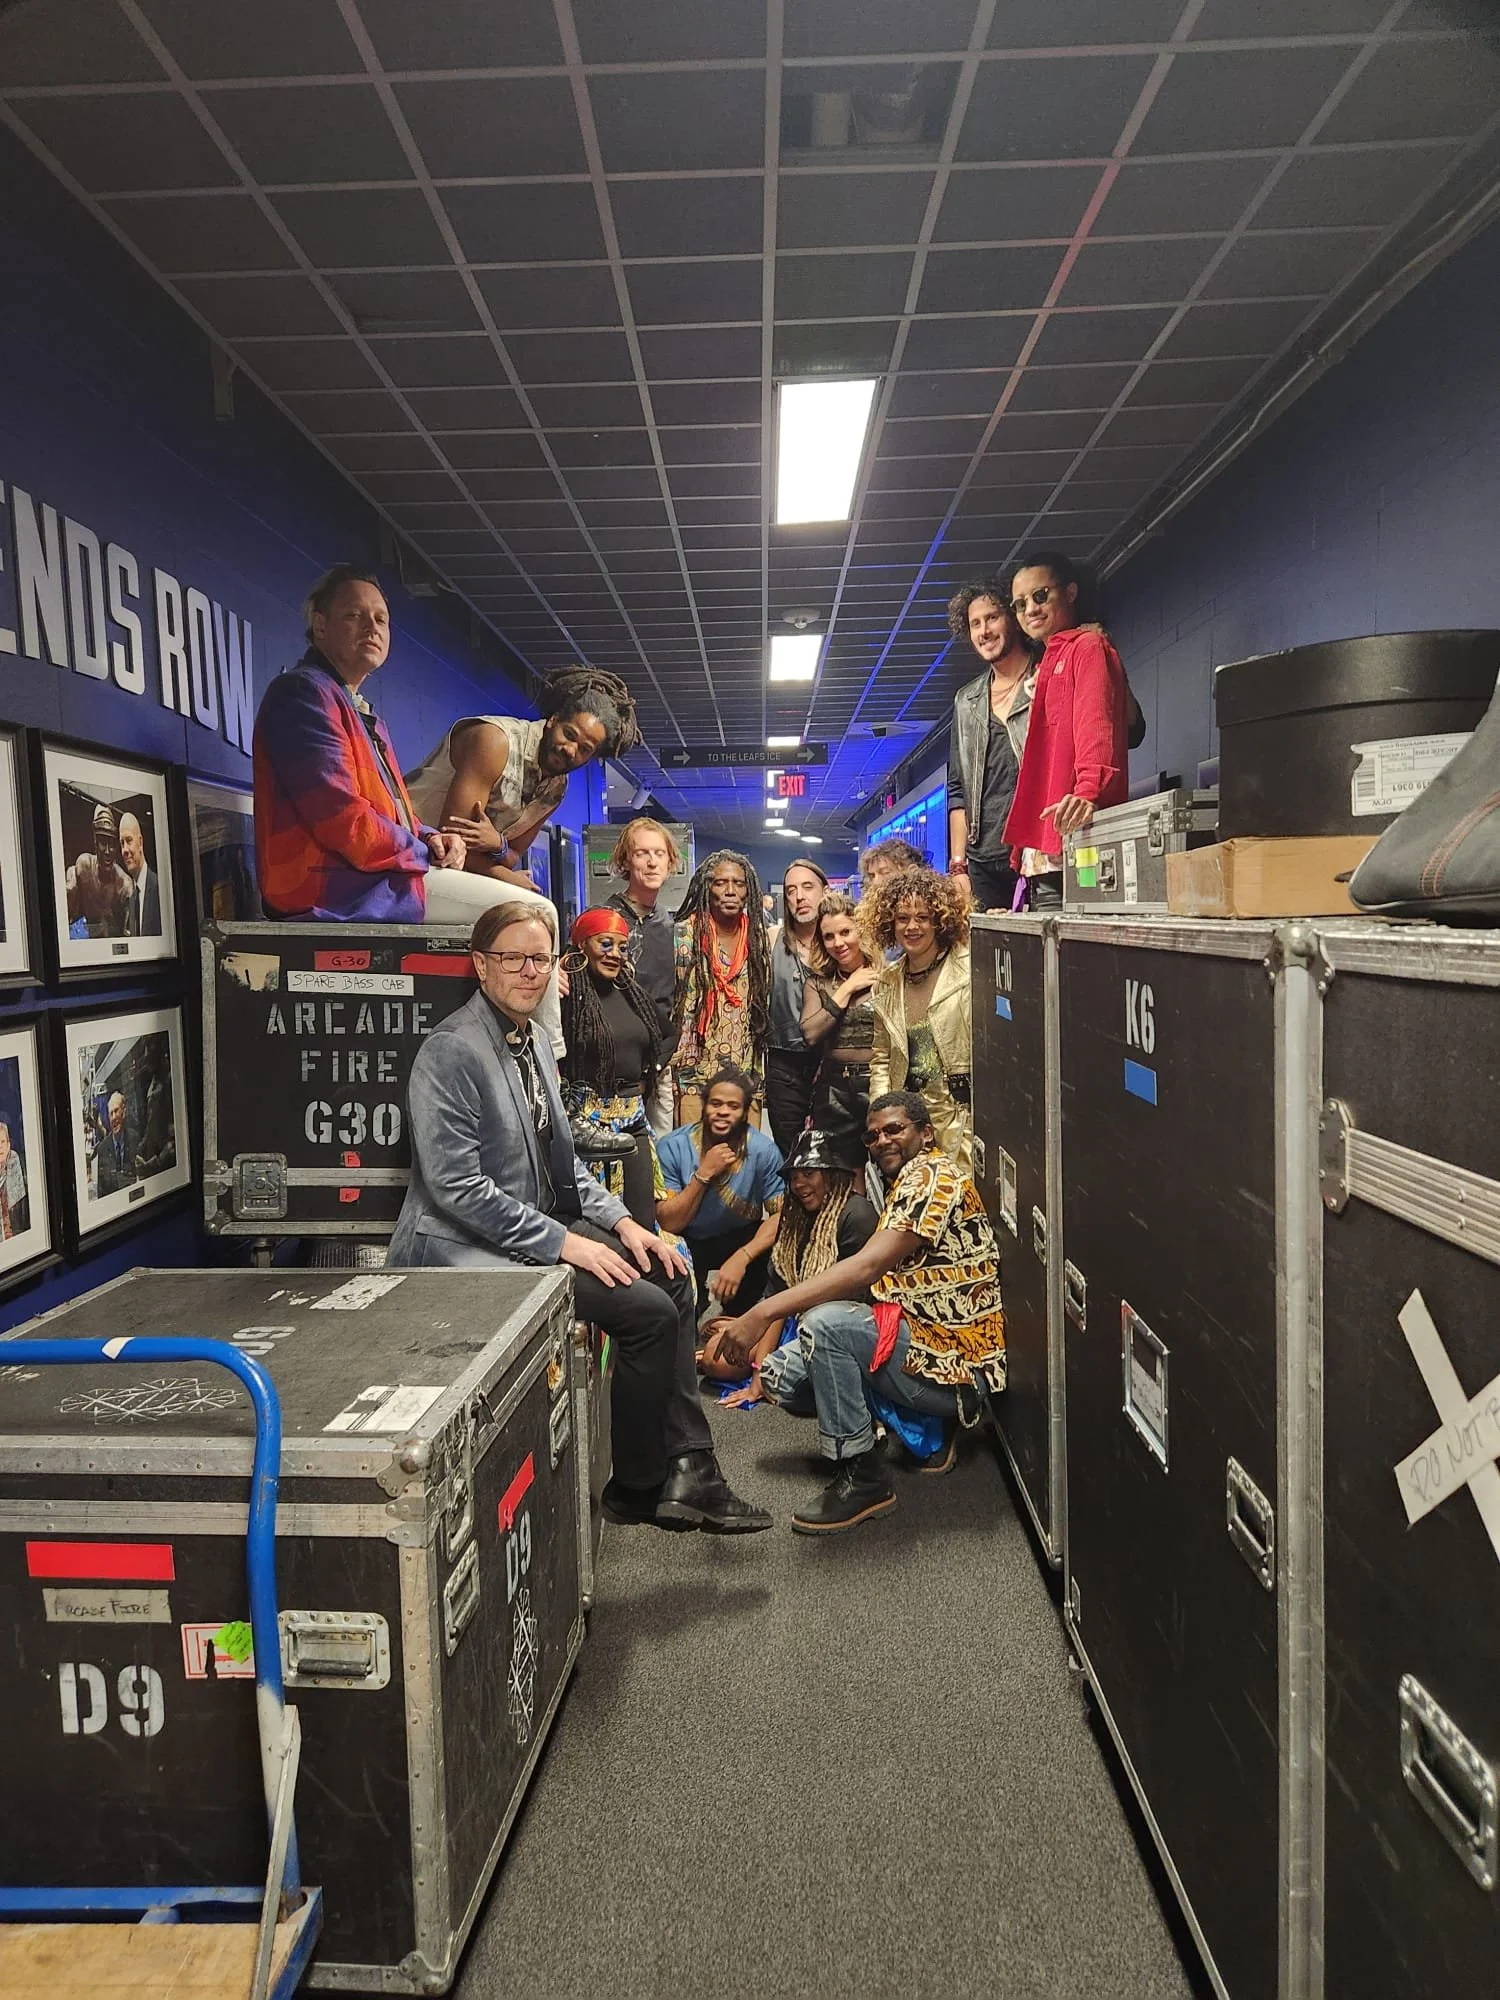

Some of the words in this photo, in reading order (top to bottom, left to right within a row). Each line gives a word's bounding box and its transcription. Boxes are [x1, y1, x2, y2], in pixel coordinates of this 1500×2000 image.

[154, 567, 253, 757] ROW
[708, 753, 719, 762] TO
[721, 753, 737, 762] THE
[739, 752, 765, 761] LEAFS
[767, 752, 781, 760] ICE
[778, 775, 805, 796] EXIT
[331, 955, 366, 967] G-30
[292, 973, 336, 989] SPARE
[343, 974, 375, 989] BASS
[381, 977, 405, 990] CAB
[266, 1002, 433, 1035] ARCADE
[1125, 978, 1155, 1054] K6
[301, 1050, 398, 1083] FIRE
[304, 1100, 401, 1146] G30
[1409, 1447, 1441, 1502] DO
[1446, 1411, 1484, 1473] NOT
[506, 1510, 531, 1605] D9
[108, 1597, 151, 1616] FIRE
[58, 1662, 165, 1737] D9
